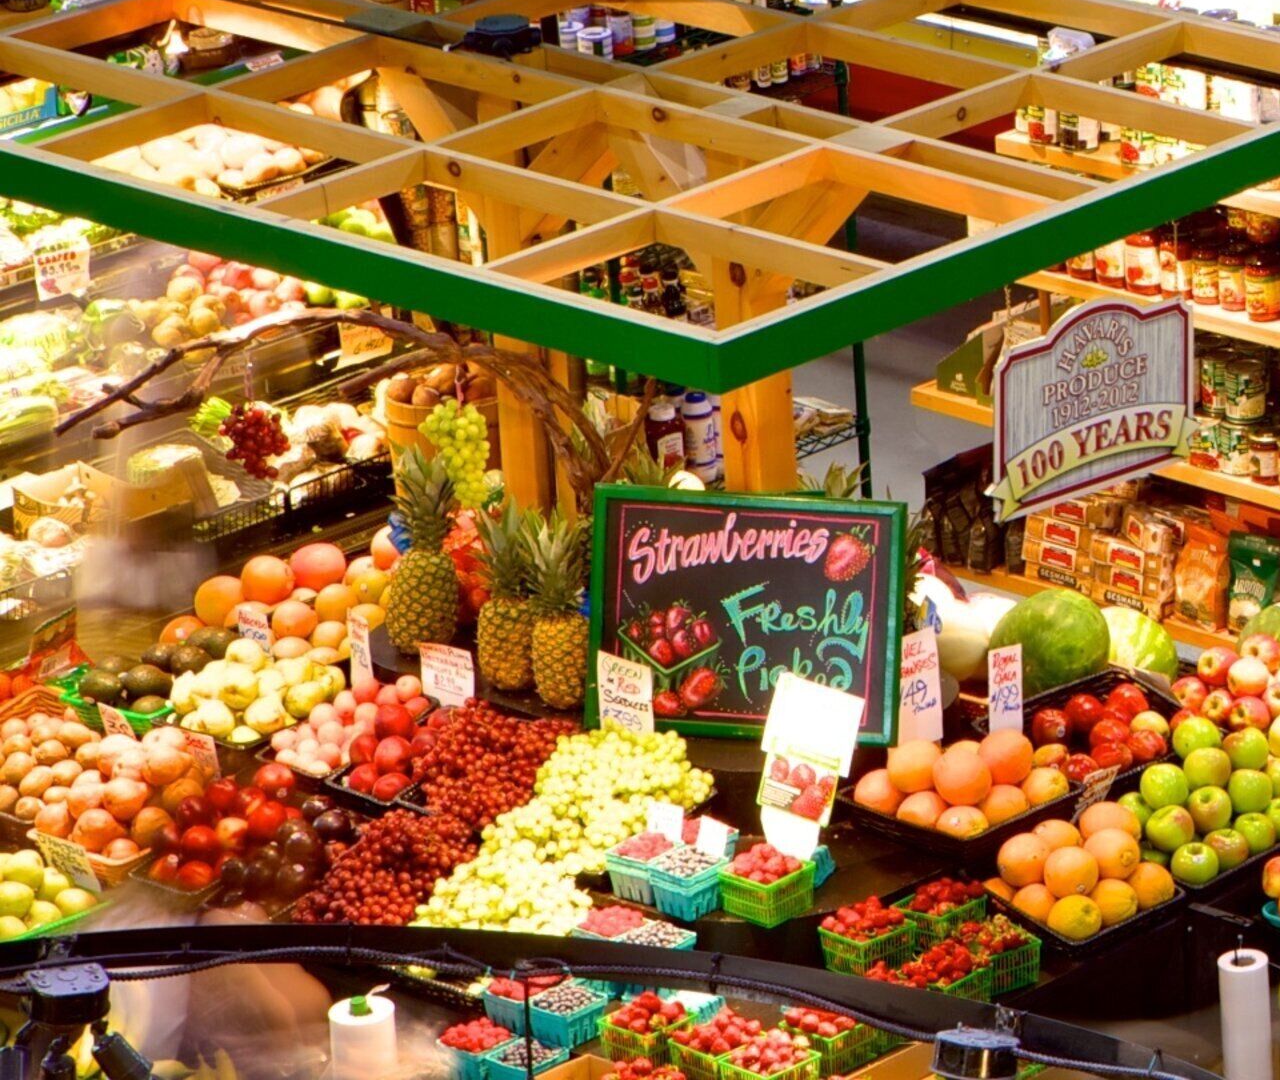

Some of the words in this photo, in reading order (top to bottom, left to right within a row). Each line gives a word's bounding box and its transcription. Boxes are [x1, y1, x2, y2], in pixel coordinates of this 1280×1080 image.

[1057, 319, 1134, 373] HAVARIS
[1042, 354, 1148, 406] PRODUCE
[1051, 382, 1139, 428] 1912-2012
[1017, 439, 1065, 489] 100
[1071, 410, 1173, 459] YEARS
[628, 512, 829, 584] Strawberries
[720, 581, 870, 664] Freshly
